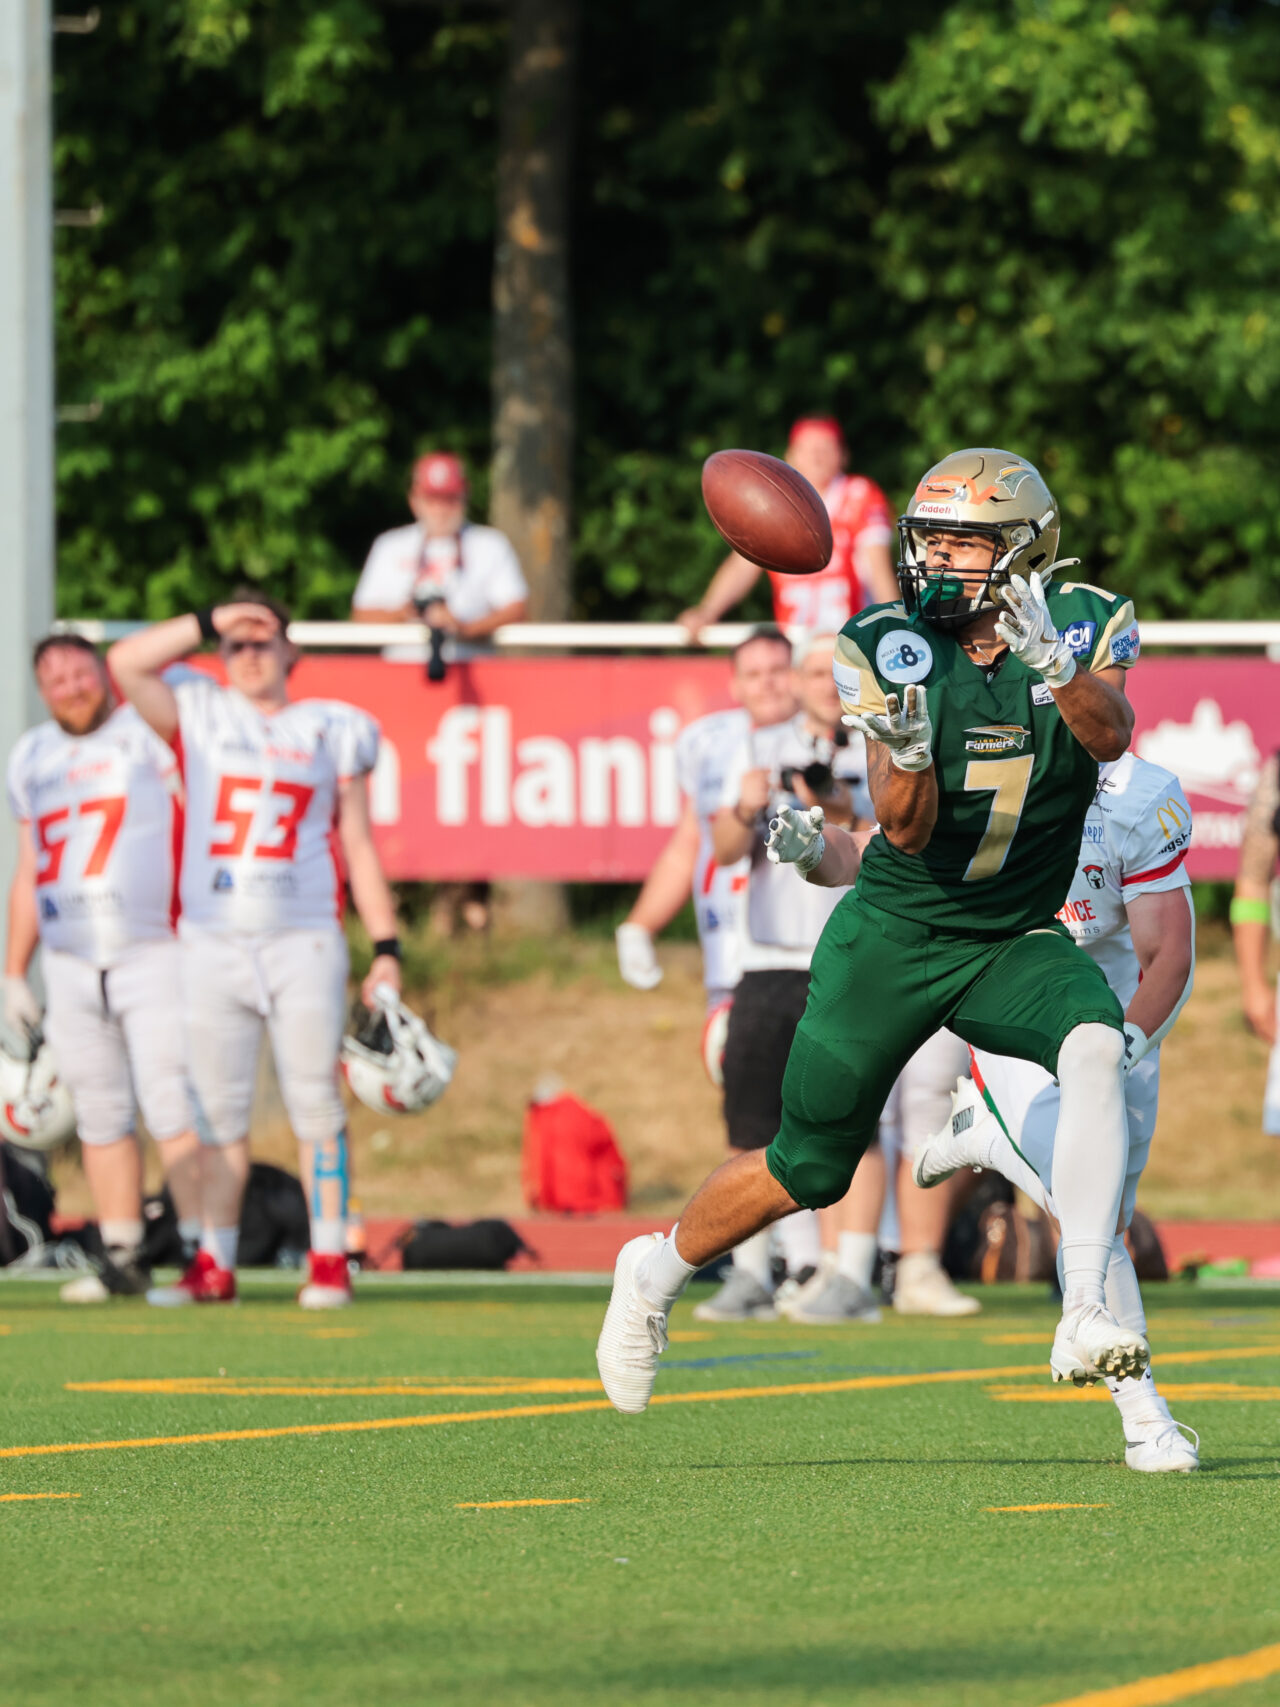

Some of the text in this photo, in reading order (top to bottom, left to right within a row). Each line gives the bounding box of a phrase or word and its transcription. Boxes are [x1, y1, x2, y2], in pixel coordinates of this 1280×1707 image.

[920, 504, 951, 514] Riddell
[1035, 696, 1052, 704] GFL
[965, 740, 1015, 750] Farmers
[36, 796, 127, 886] 57
[209, 775, 315, 860] 53
[962, 754, 1035, 881] 7
